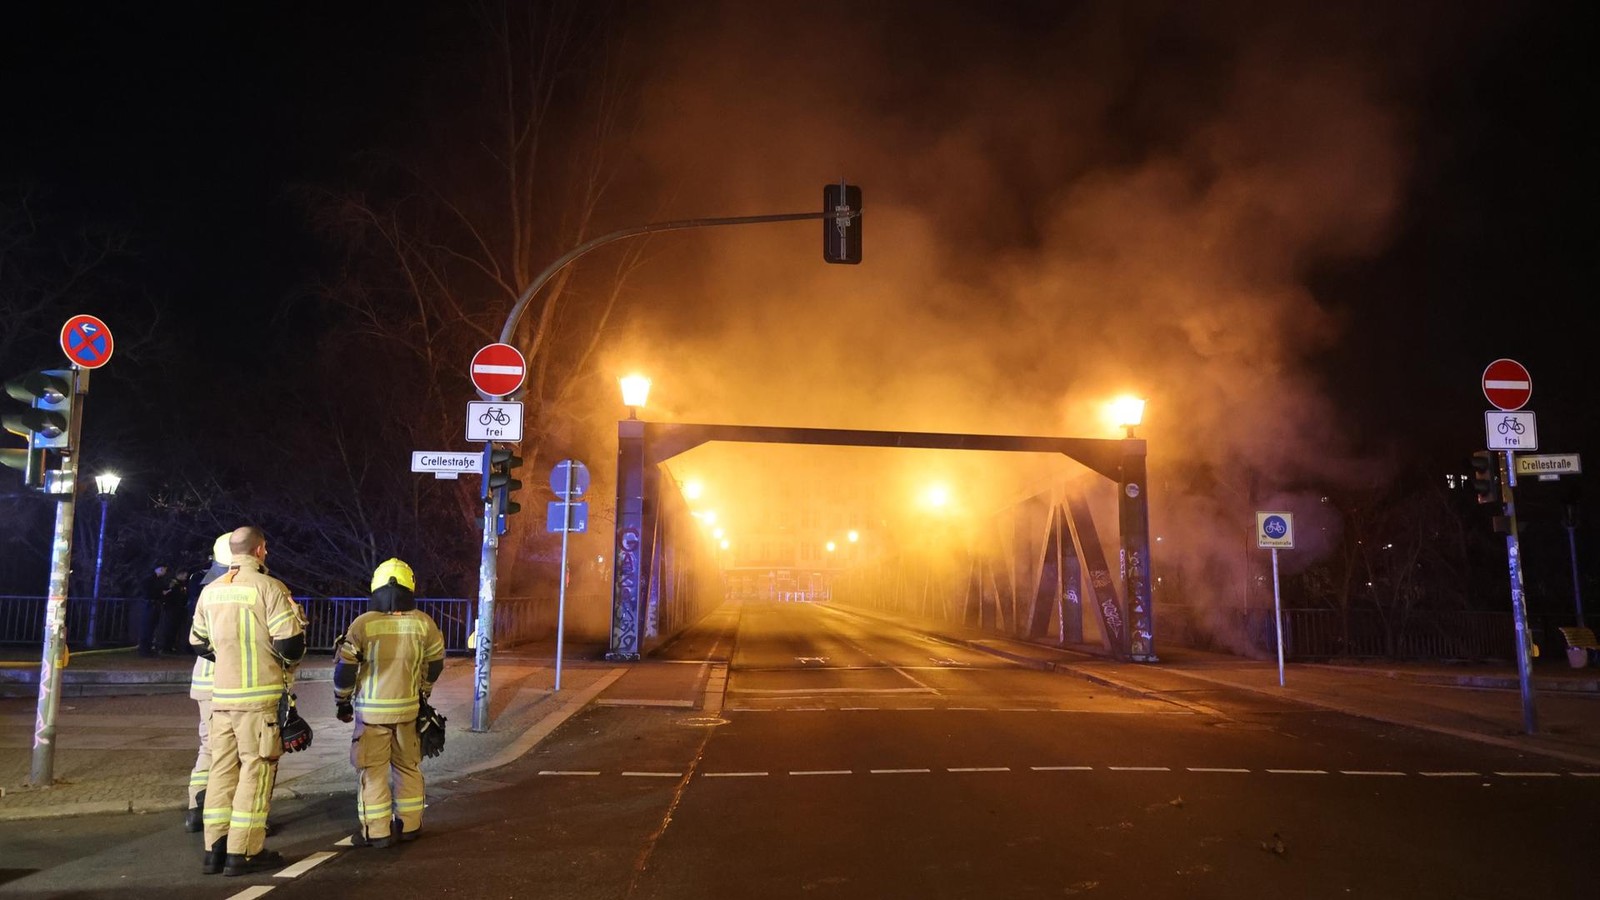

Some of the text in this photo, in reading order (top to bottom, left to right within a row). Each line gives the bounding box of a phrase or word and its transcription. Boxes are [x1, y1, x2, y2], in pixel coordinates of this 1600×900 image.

[486, 427, 503, 437] frei
[1505, 436, 1520, 445] frei
[421, 456, 475, 469] Crellestraße
[1522, 459, 1571, 471] Crellestraße
